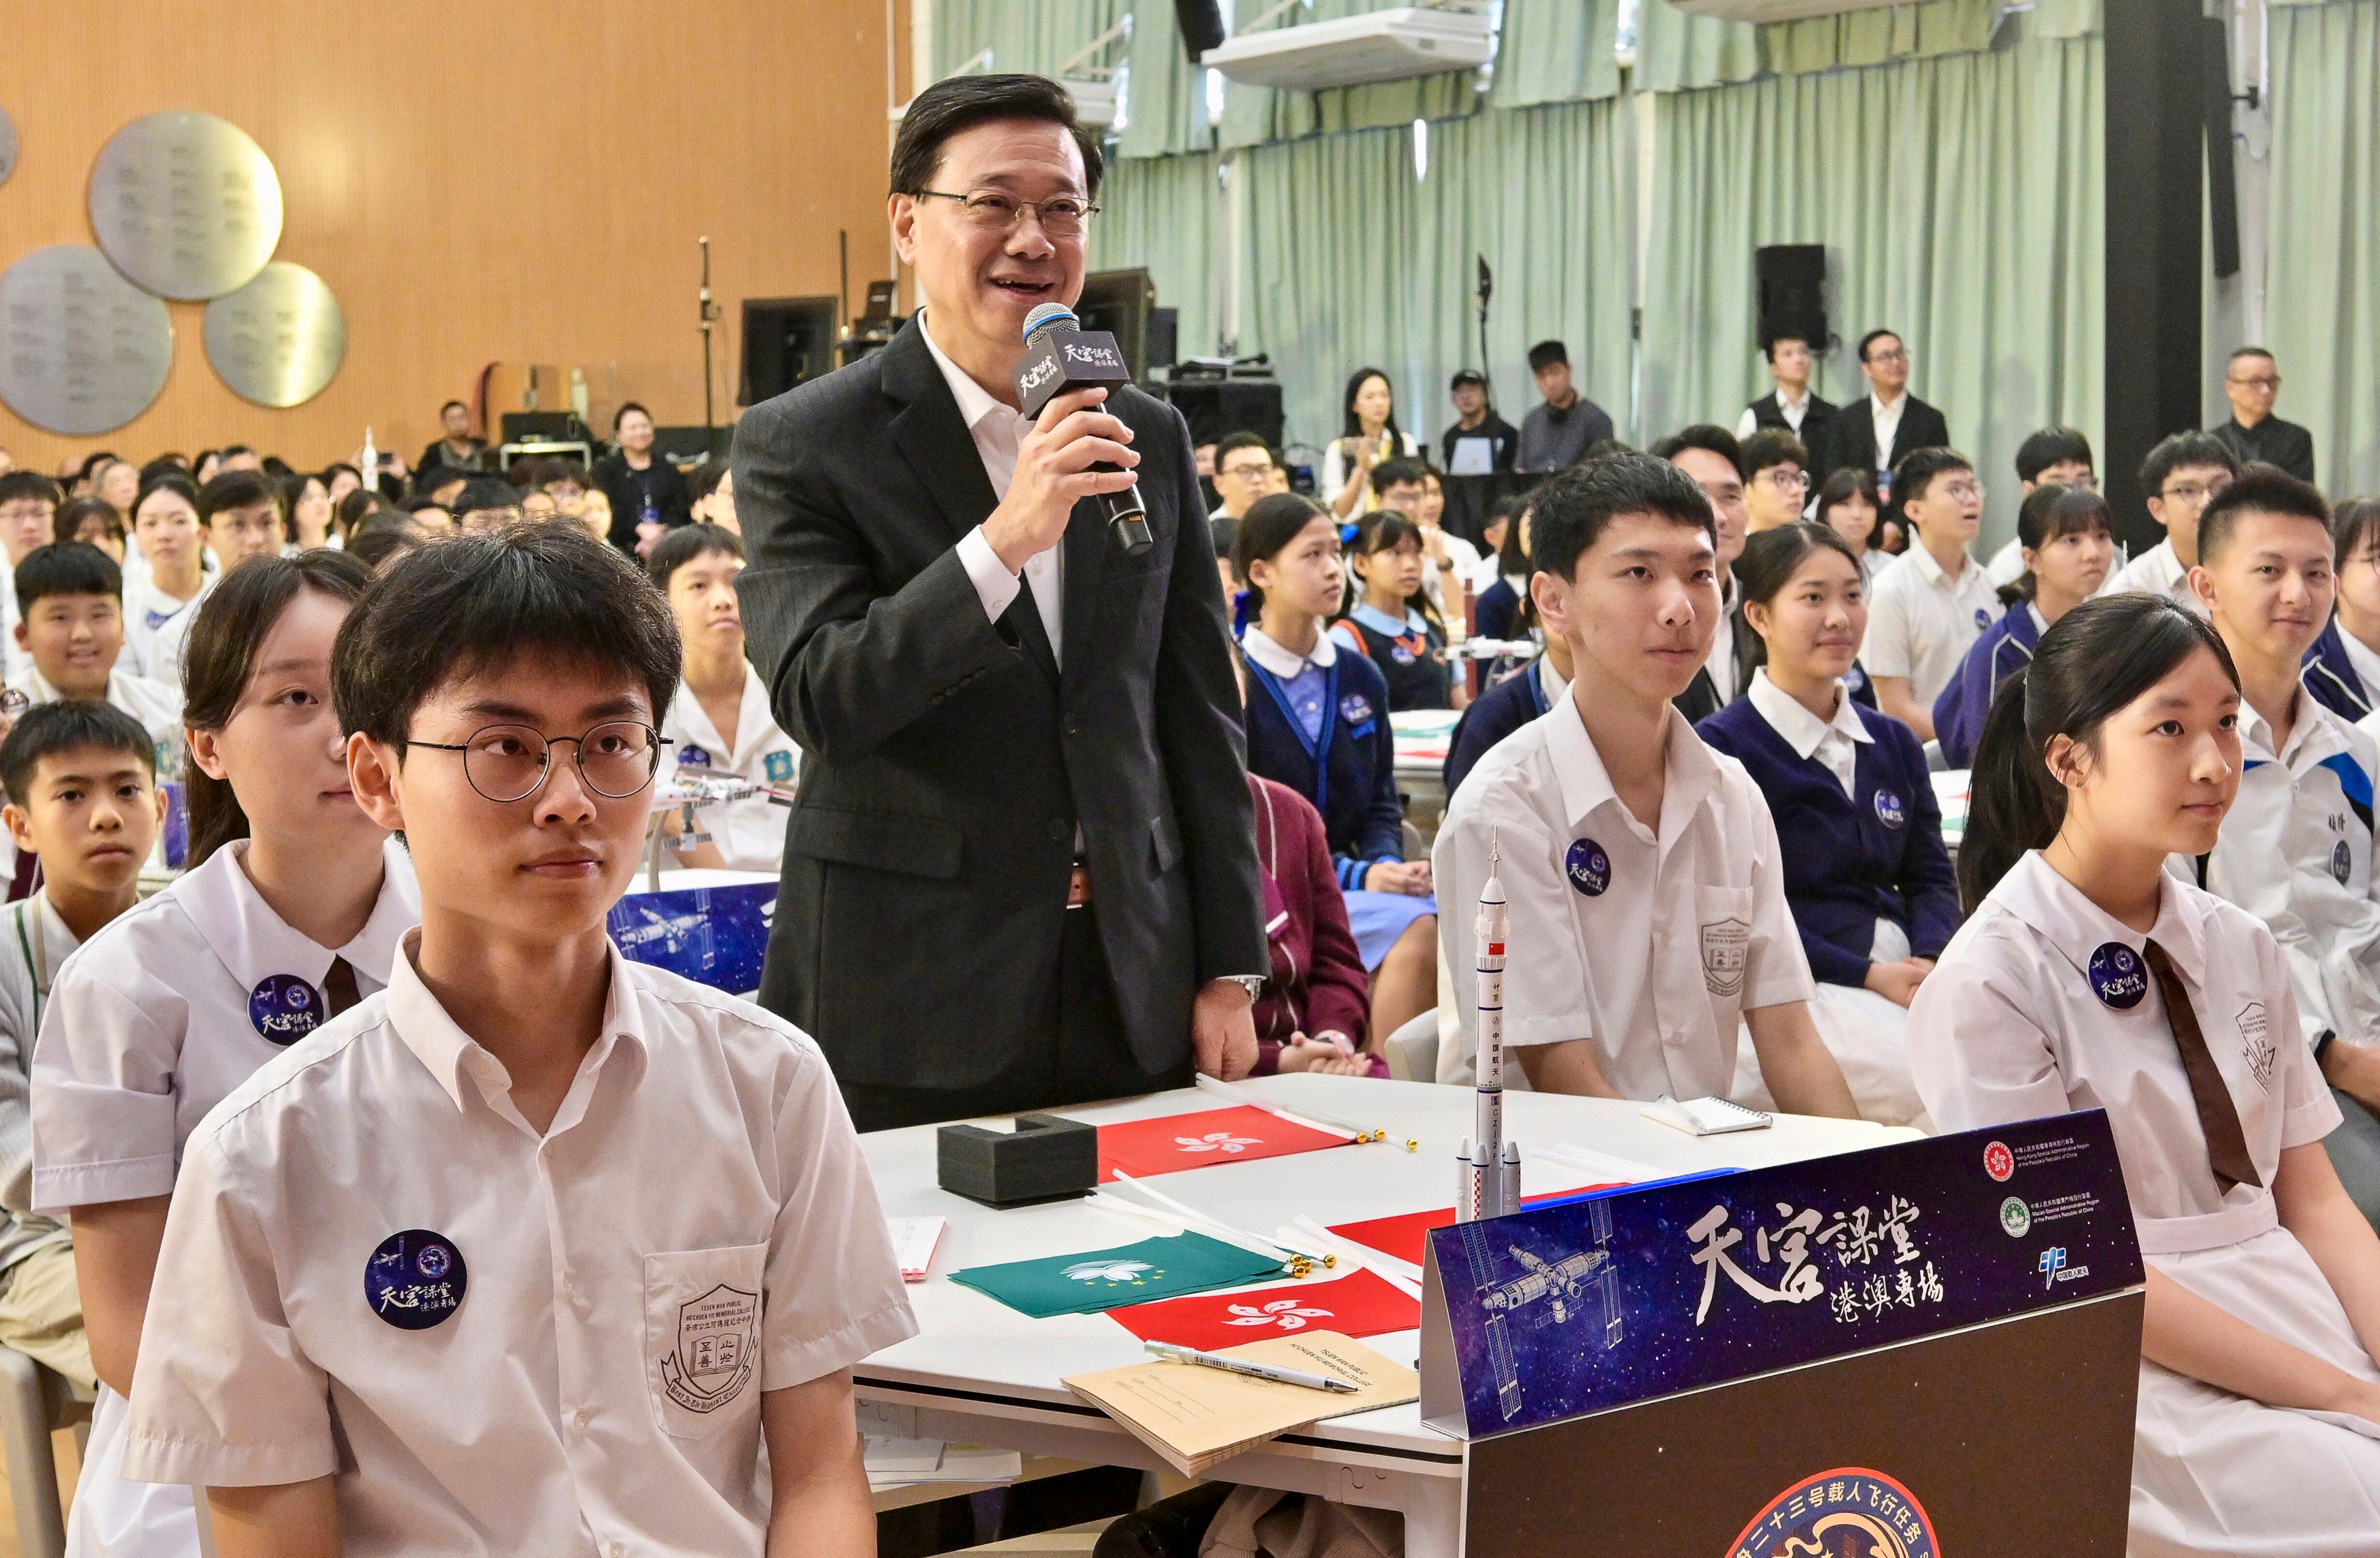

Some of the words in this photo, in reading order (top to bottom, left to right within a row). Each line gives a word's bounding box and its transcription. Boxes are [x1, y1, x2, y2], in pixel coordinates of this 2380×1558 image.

[2051, 1146, 2076, 1155] Administrative
[2046, 1206, 2059, 1214] Special
[2060, 1202, 2086, 1212] Administrative
[2086, 1199, 2099, 1207] Region
[2062, 1210, 2078, 1218] Republic
[1830, 1261, 1944, 1324] 港澳專場
[1320, 1349, 1339, 1361] TSUEN
[1348, 1364, 1368, 1375] PUBLIC
[1322, 1360, 1348, 1375] MEMORIAL
[1347, 1374, 1373, 1387] COLLEGE
[723, 1371, 749, 1400] Excellence
